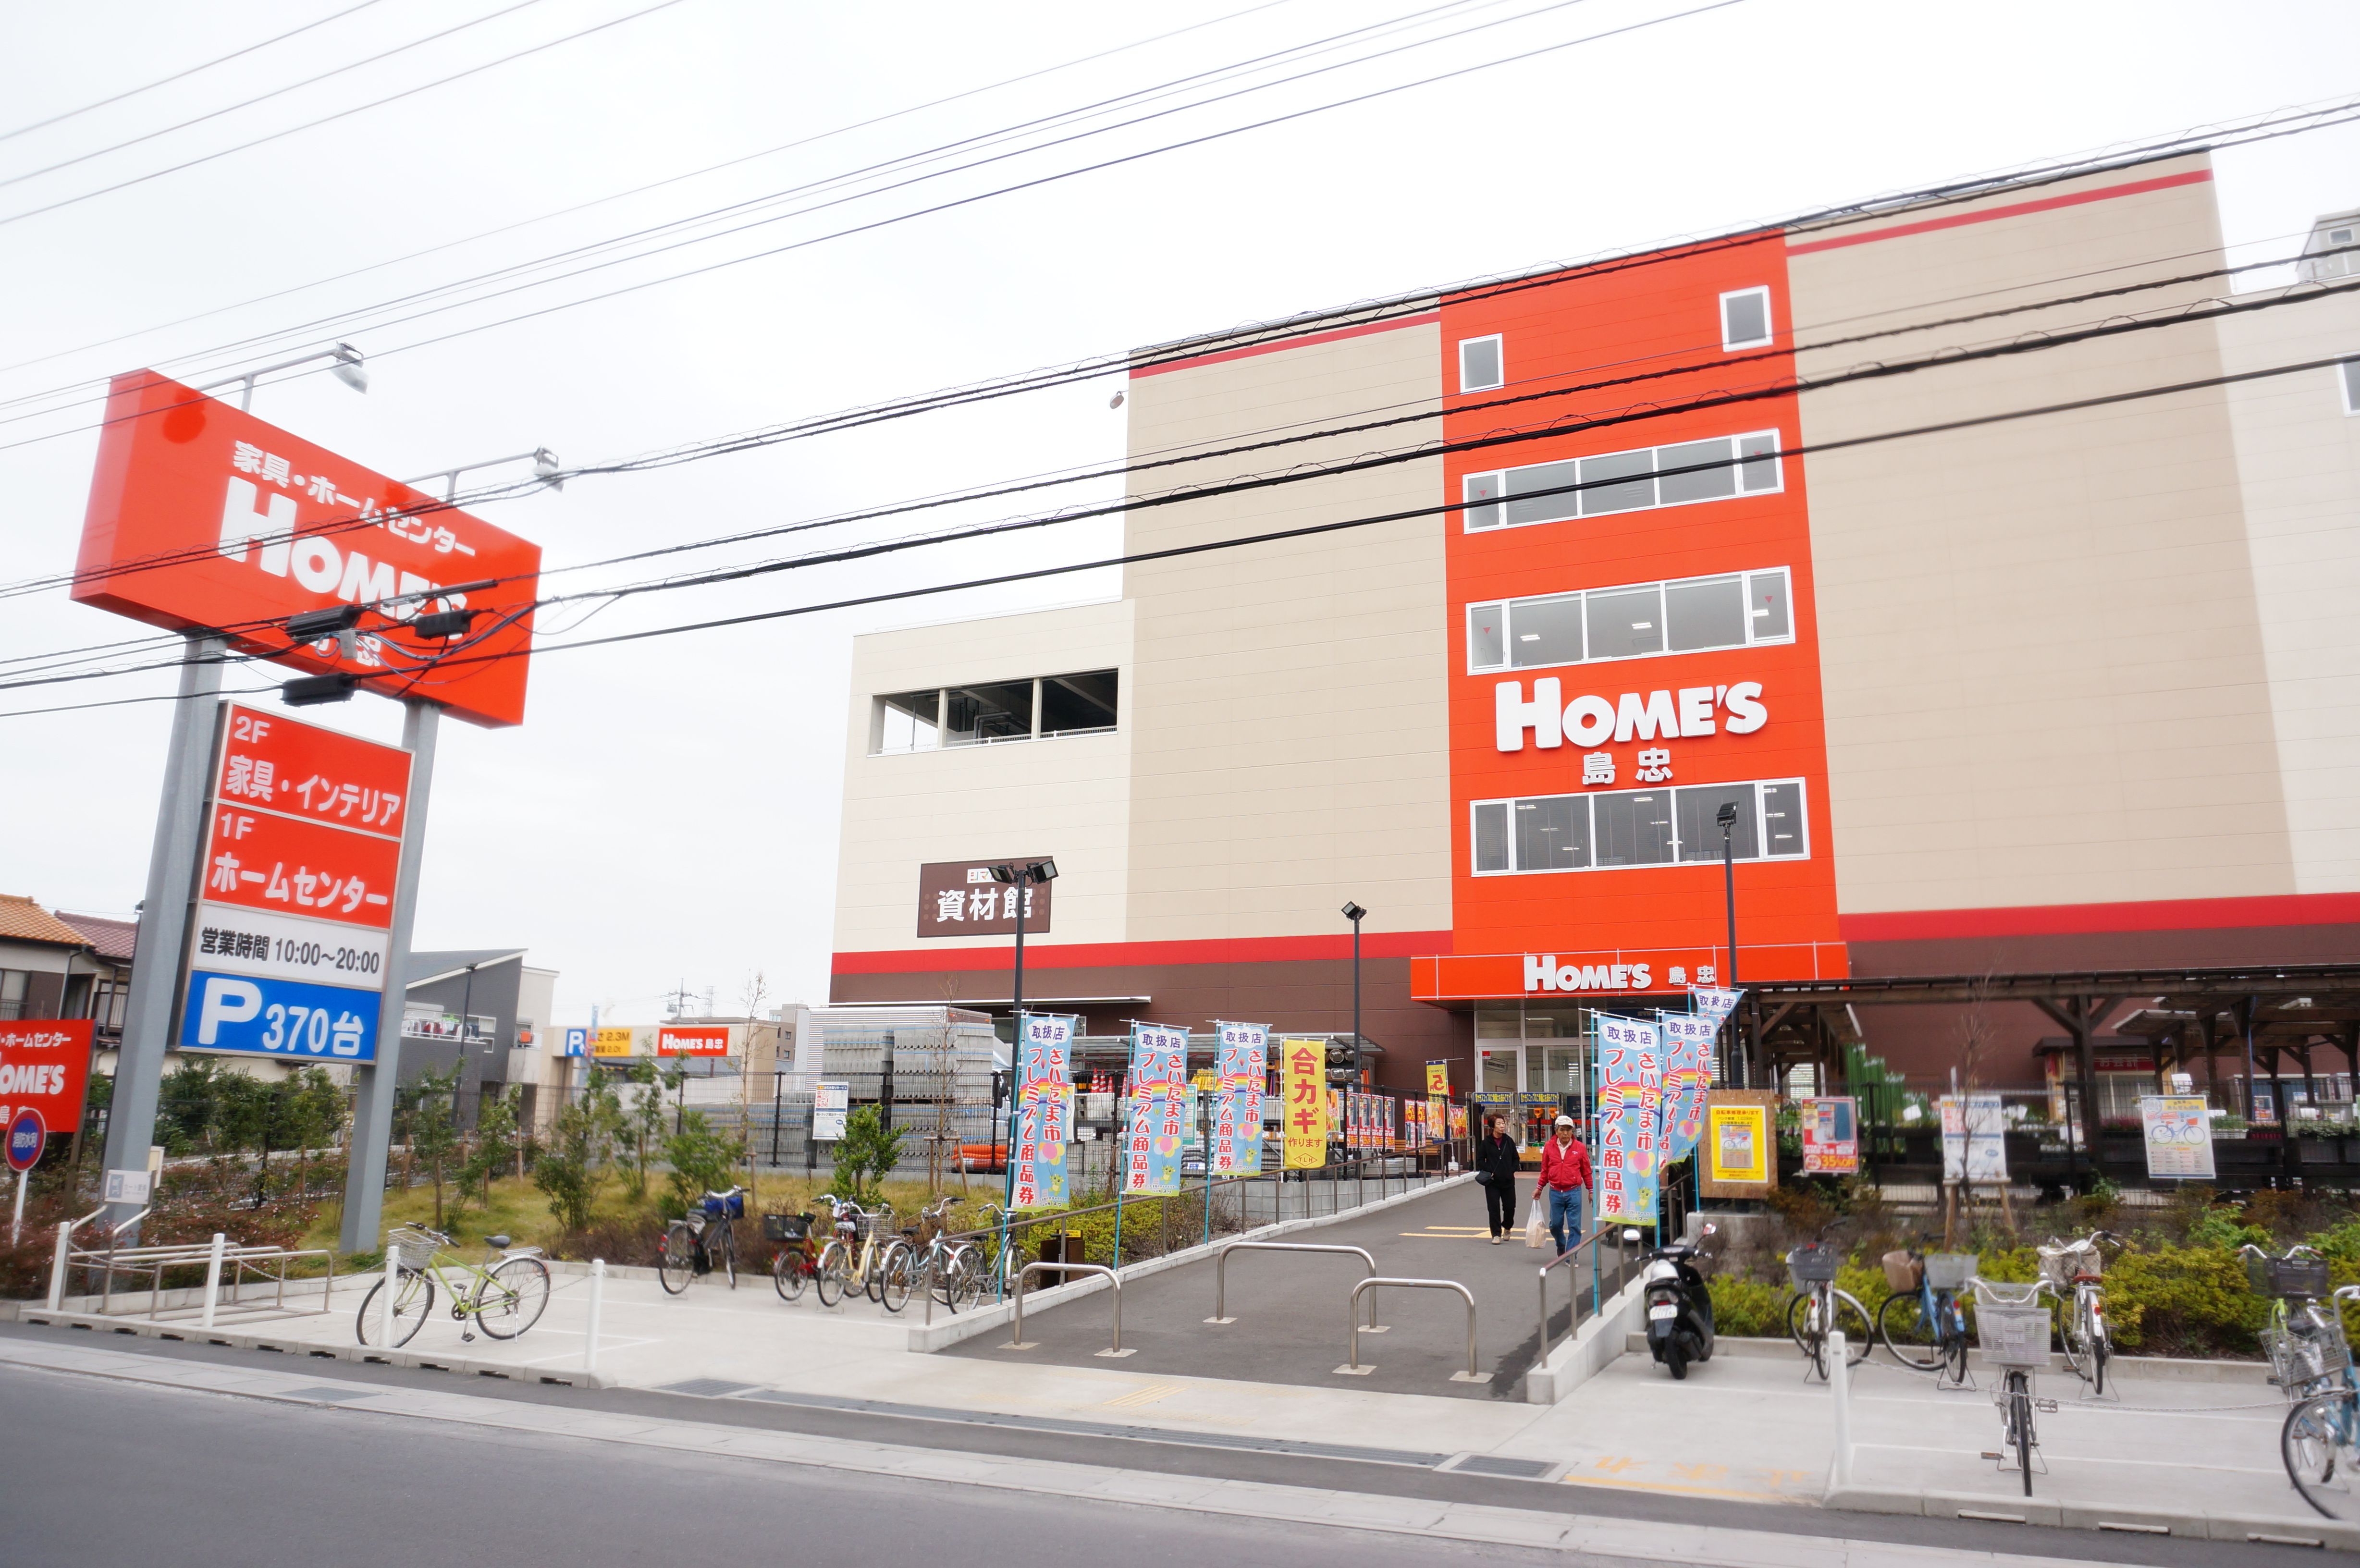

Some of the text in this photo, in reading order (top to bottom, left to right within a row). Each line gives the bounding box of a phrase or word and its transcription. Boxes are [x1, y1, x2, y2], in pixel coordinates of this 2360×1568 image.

[234, 715, 271, 744] 2F
[1496, 677, 1768, 752] HOME'S
[1582, 747, 1673, 785] 島忠
[226, 755, 401, 827] 家具・インテリア
[221, 813, 255, 840] 1F
[211, 852, 388, 914] ホームセンター
[936, 886, 1032, 922] 資材館
[200, 928, 269, 961] 営業時間
[1524, 956, 1716, 992] HOME'S 島忠
[198, 978, 364, 1056] P 370台
[1699, 995, 1733, 1009] 取扱店
[662, 1034, 723, 1049] HOME'S 島忠
[1032, 1025, 1065, 1041] 取扱店
[1142, 1034, 1180, 1049] 取扱店
[1226, 1031, 1262, 1043] 取扱店
[1607, 1026, 1652, 1045] 取扱店
[1670, 1022, 1711, 1037] 取扱店
[0, 1057, 65, 1095] OME'S
[1044, 1048, 1063, 1141] さいたま市
[1164, 1054, 1183, 1136] さいたま市
[1245, 1050, 1263, 1123] さいたま市
[1290, 1047, 1319, 1134] 合カギ
[1689, 1043, 1711, 1120] さいたま市
[1132, 1053, 1156, 1188] プレミアム商品券
[1219, 1049, 1238, 1169] プレミアム商品券
[1638, 1053, 1656, 1151] さいたま市
[1019, 1046, 1043, 1204] プレミアム商品券
[1288, 1137, 1323, 1148] 作ります
[1604, 1049, 1624, 1213] プレミアム商品券
